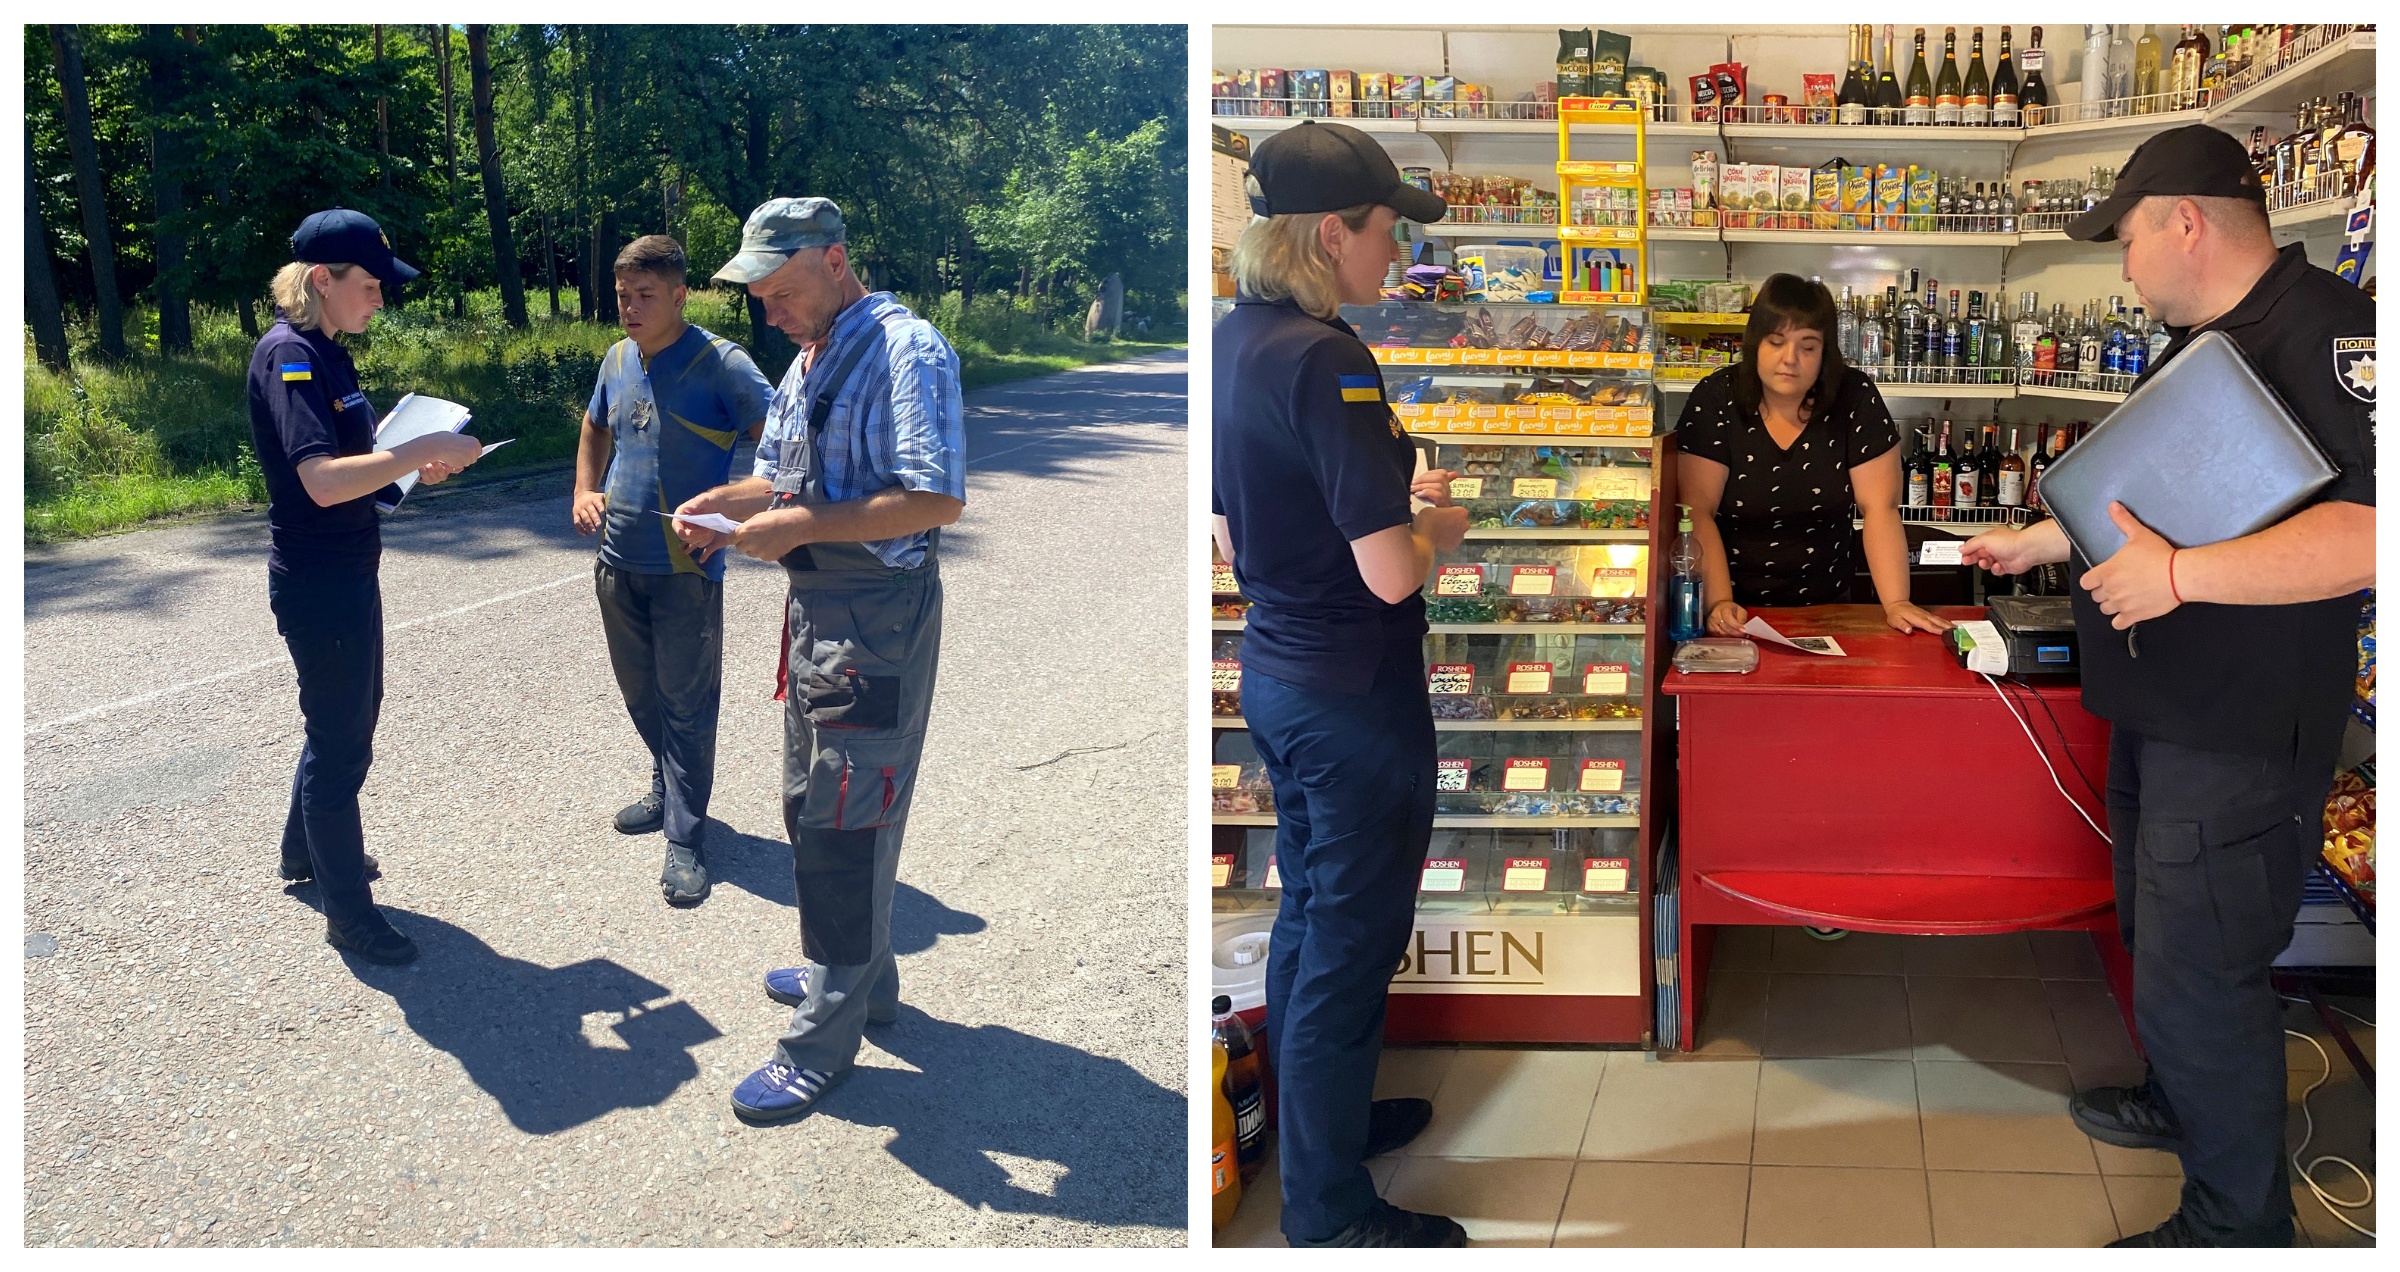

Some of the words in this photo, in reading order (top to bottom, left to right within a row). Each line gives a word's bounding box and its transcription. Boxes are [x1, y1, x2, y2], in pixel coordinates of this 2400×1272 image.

[1560, 64, 1588, 73] JACOBS
[2339, 340, 2376, 350] ПОЛІЦ
[1638, 354, 1653, 367] Lac
[1437, 665, 1467, 673] ROSHEN
[1516, 664, 1546, 672] ROSHEN
[1593, 665, 1622, 673] ROSHEN
[1513, 760, 1543, 768] ROSHEN
[1589, 761, 1619, 769] ROSHEN
[1430, 860, 1460, 868] ROSHEN
[1512, 860, 1543, 868] ROSHEN
[1592, 860, 1622, 868] ROSHEN
